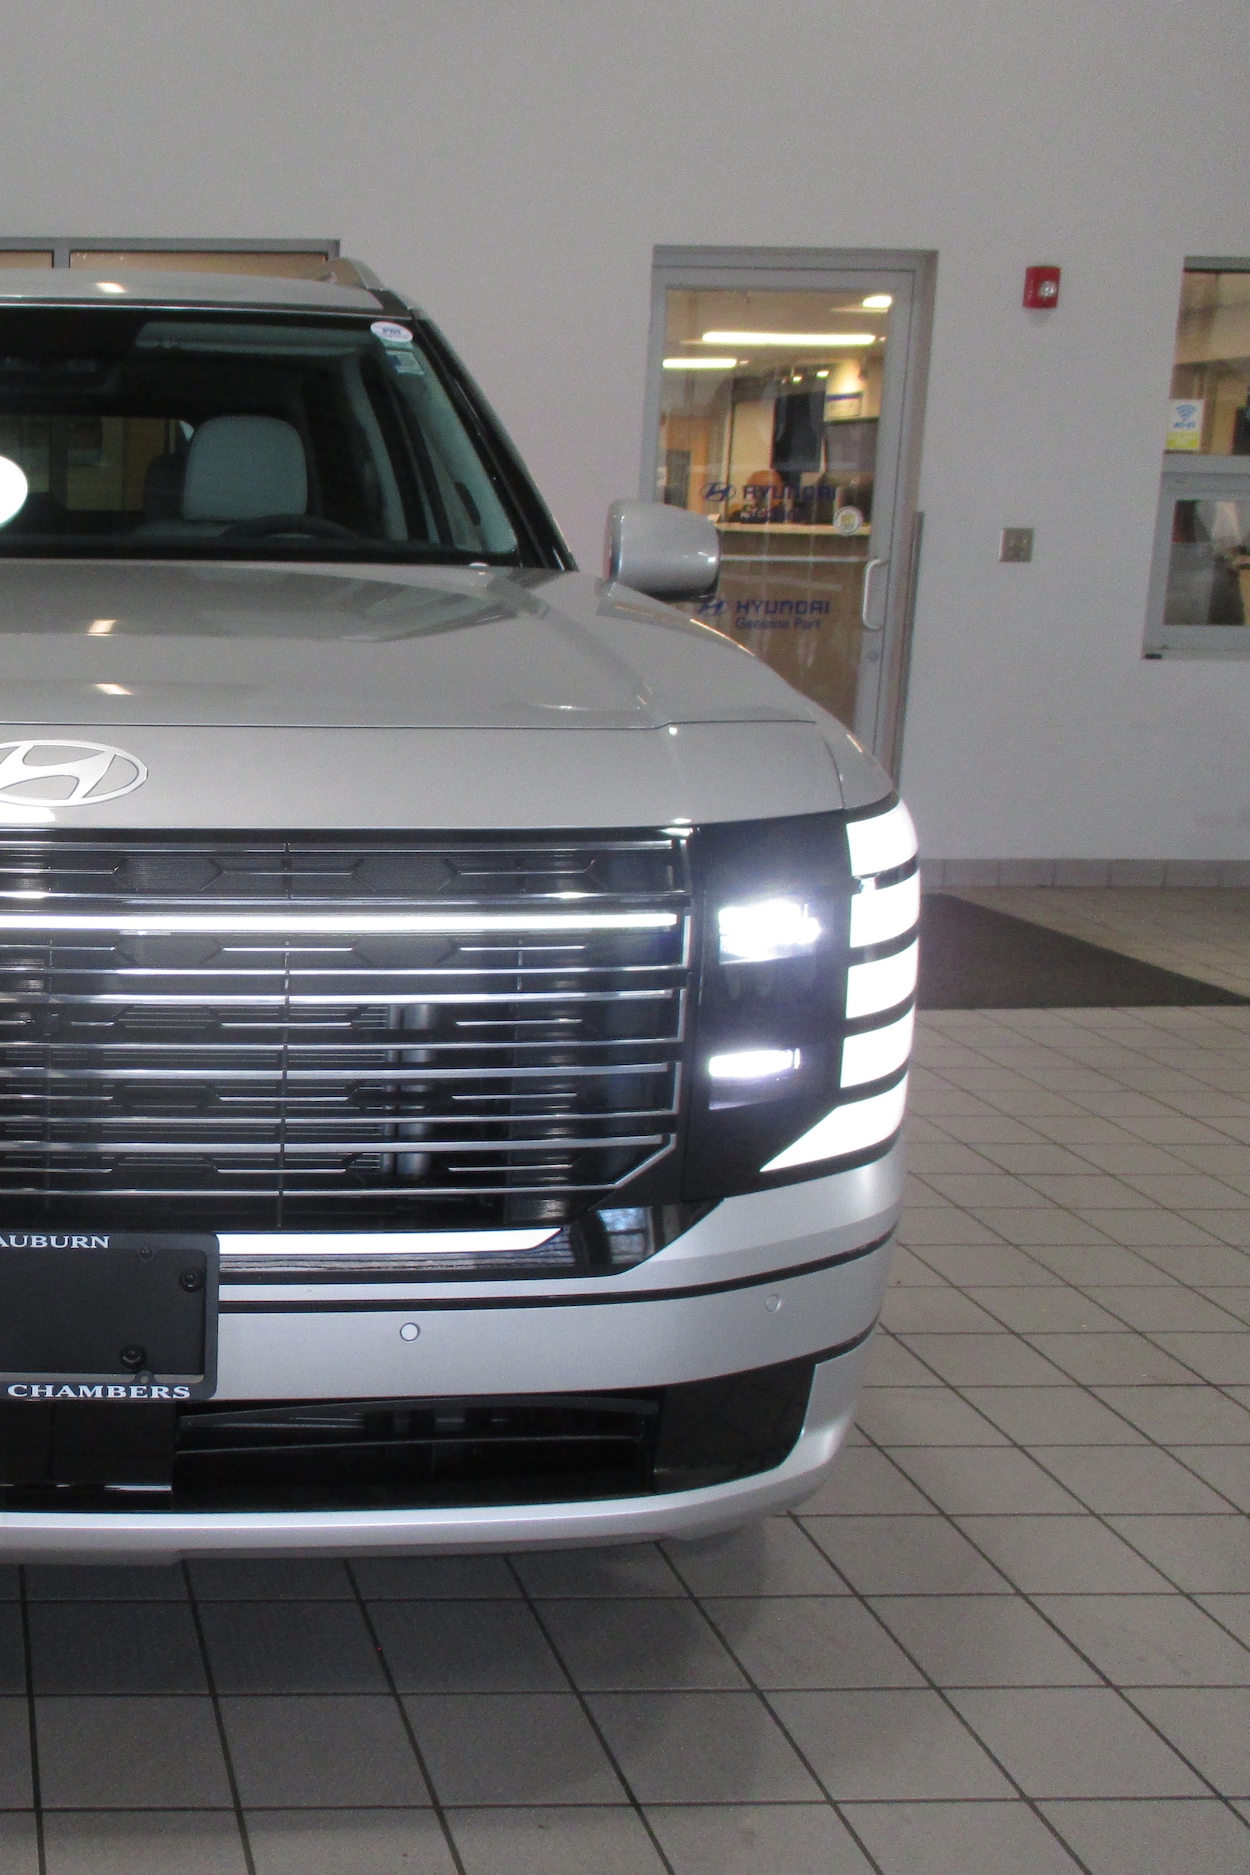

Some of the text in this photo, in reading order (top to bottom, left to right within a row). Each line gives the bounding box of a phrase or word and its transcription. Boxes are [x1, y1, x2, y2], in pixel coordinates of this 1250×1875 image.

[743, 484, 836, 501] HYUNDAI
[735, 600, 830, 615] HYUNDAI
[735, 616, 790, 630] Genuine
[7, 1384, 191, 1399] CHAMBERS
